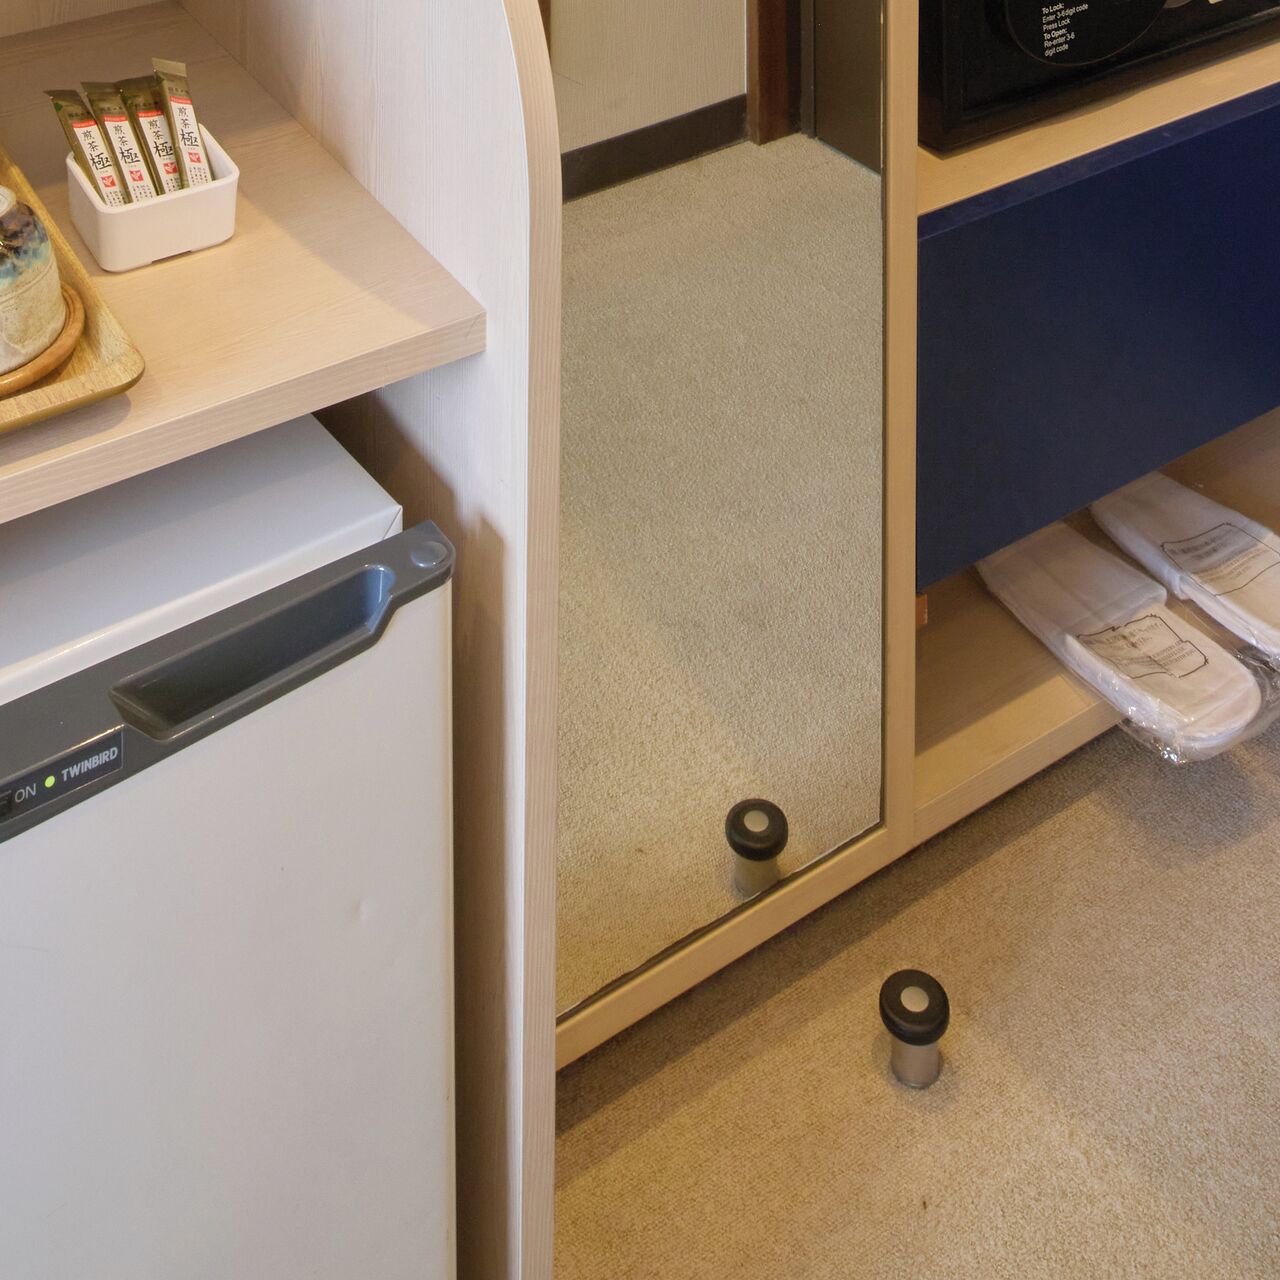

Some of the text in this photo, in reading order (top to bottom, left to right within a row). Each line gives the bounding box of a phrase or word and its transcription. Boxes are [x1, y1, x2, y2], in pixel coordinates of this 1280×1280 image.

[1076, 4, 1088, 12] code
[1043, 17, 1070, 32] Press Lock
[1056, 44, 1069, 53] code
[61, 746, 118, 782] TWINBIRD
[14, 783, 37, 803] ON
